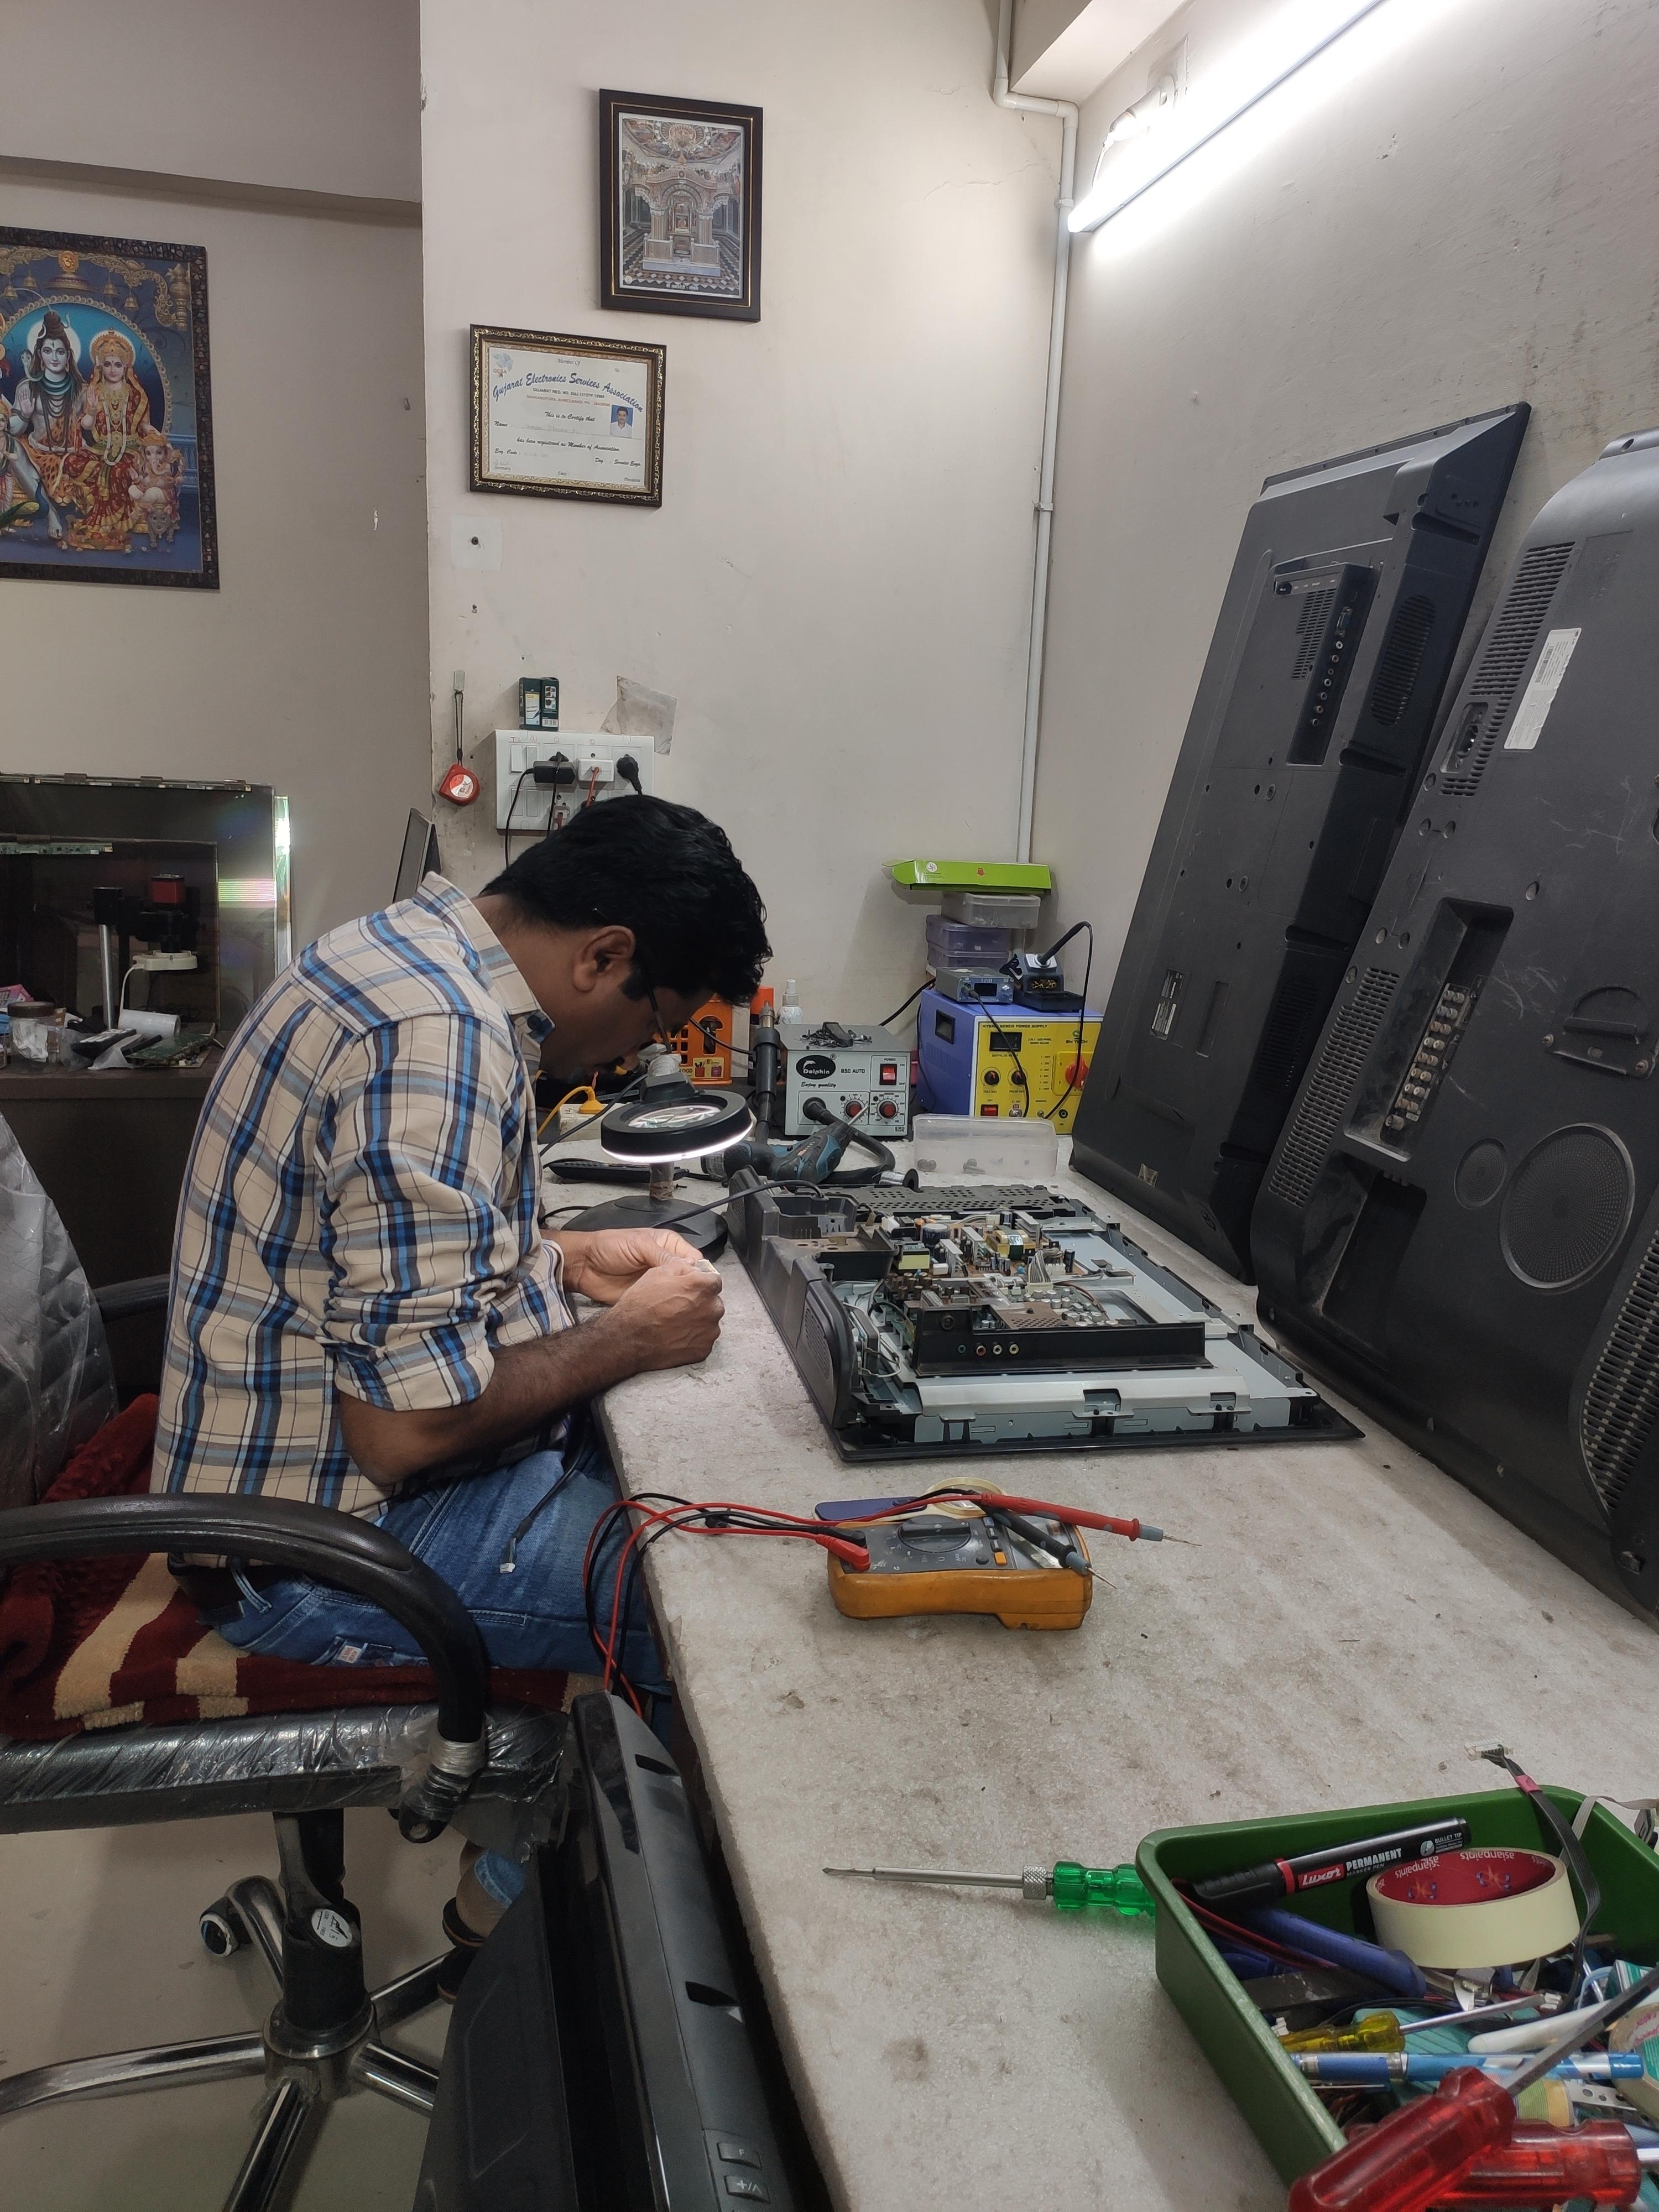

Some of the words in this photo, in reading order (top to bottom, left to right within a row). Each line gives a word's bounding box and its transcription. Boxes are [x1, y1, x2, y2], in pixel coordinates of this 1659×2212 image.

[493, 378, 523, 402] Gujarat
[526, 373, 566, 386] Electronics
[569, 373, 600, 389] Services
[602, 382, 643, 413] Association
[567, 414, 584, 422] Certify
[1434, 1834, 1453, 1844] BULLET
[1346, 1848, 1402, 1871] PERMANENT
[1302, 1867, 1342, 1886] Luxor
[1347, 1865, 1371, 1876] MARKER
